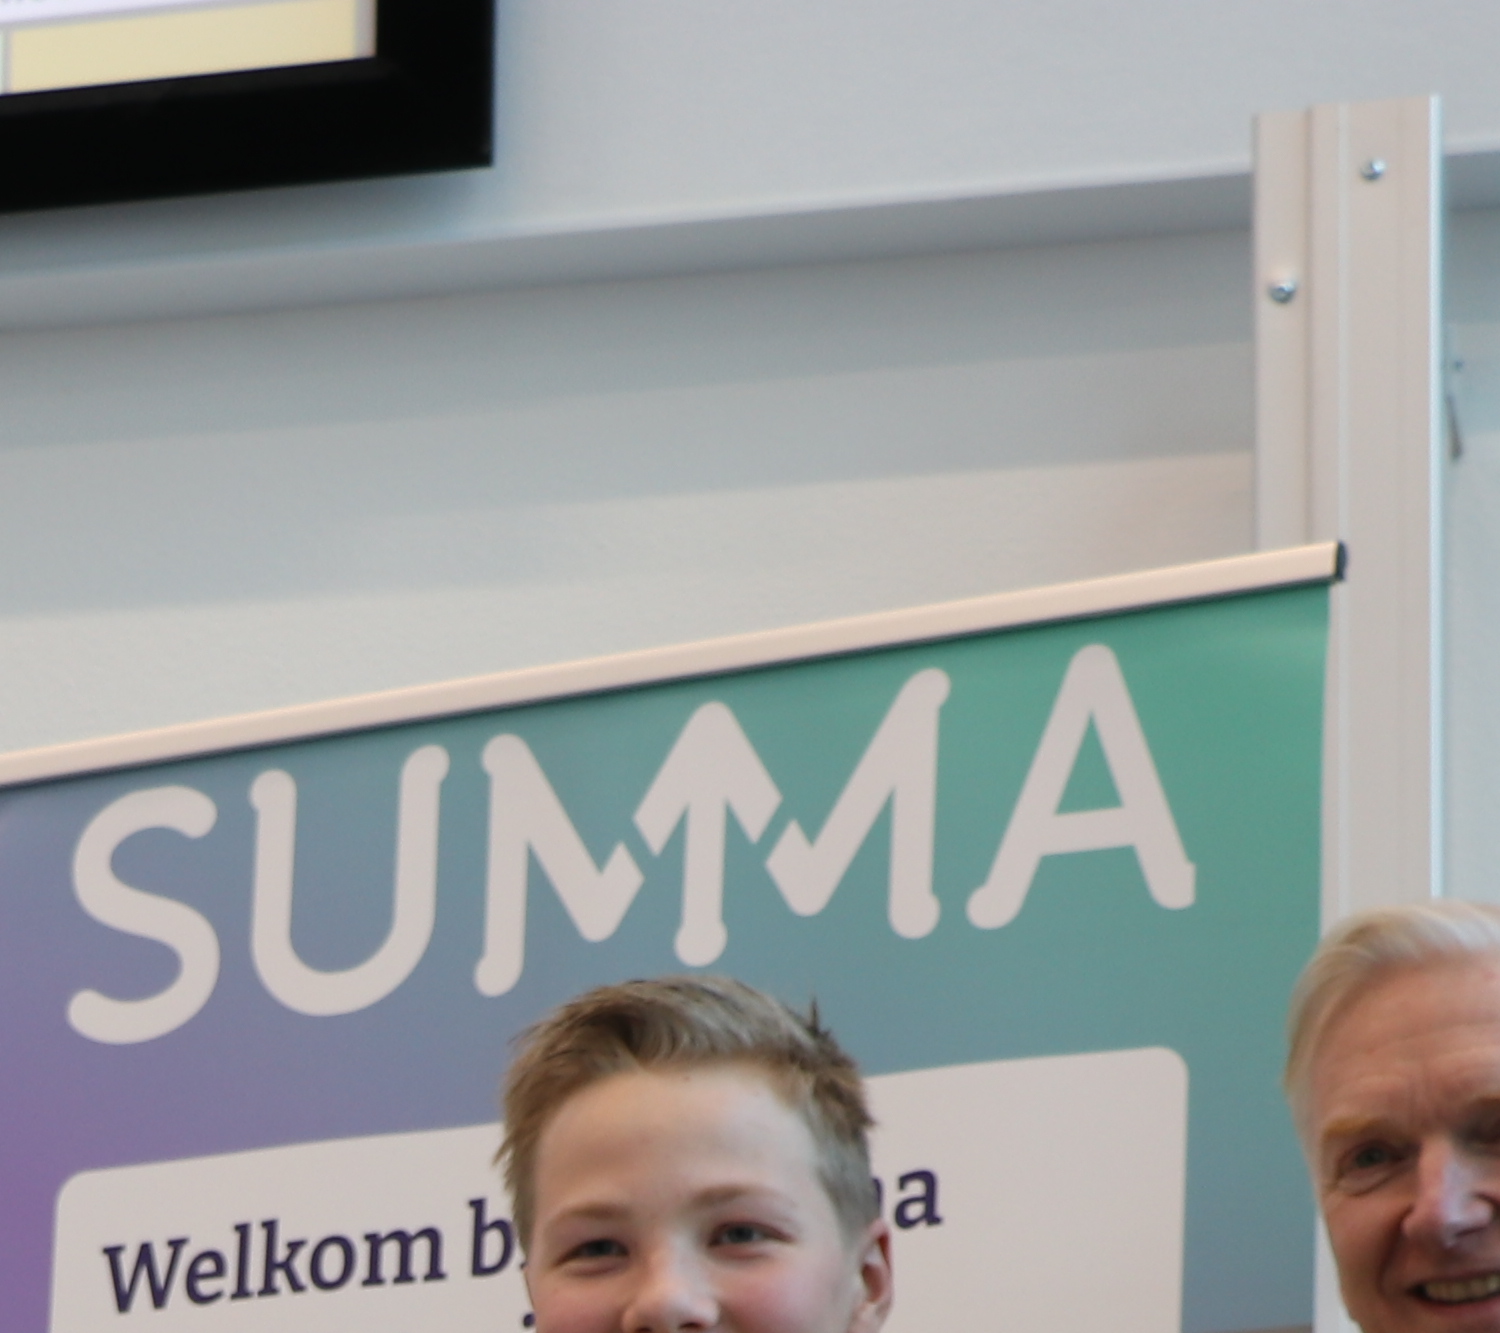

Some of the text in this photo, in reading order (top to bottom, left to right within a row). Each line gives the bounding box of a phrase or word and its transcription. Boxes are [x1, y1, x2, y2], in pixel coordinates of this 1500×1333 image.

[67, 643, 1195, 1043] SUMMA
[103, 1219, 448, 1313] Welkom
[468, 1198, 528, 1277] b
